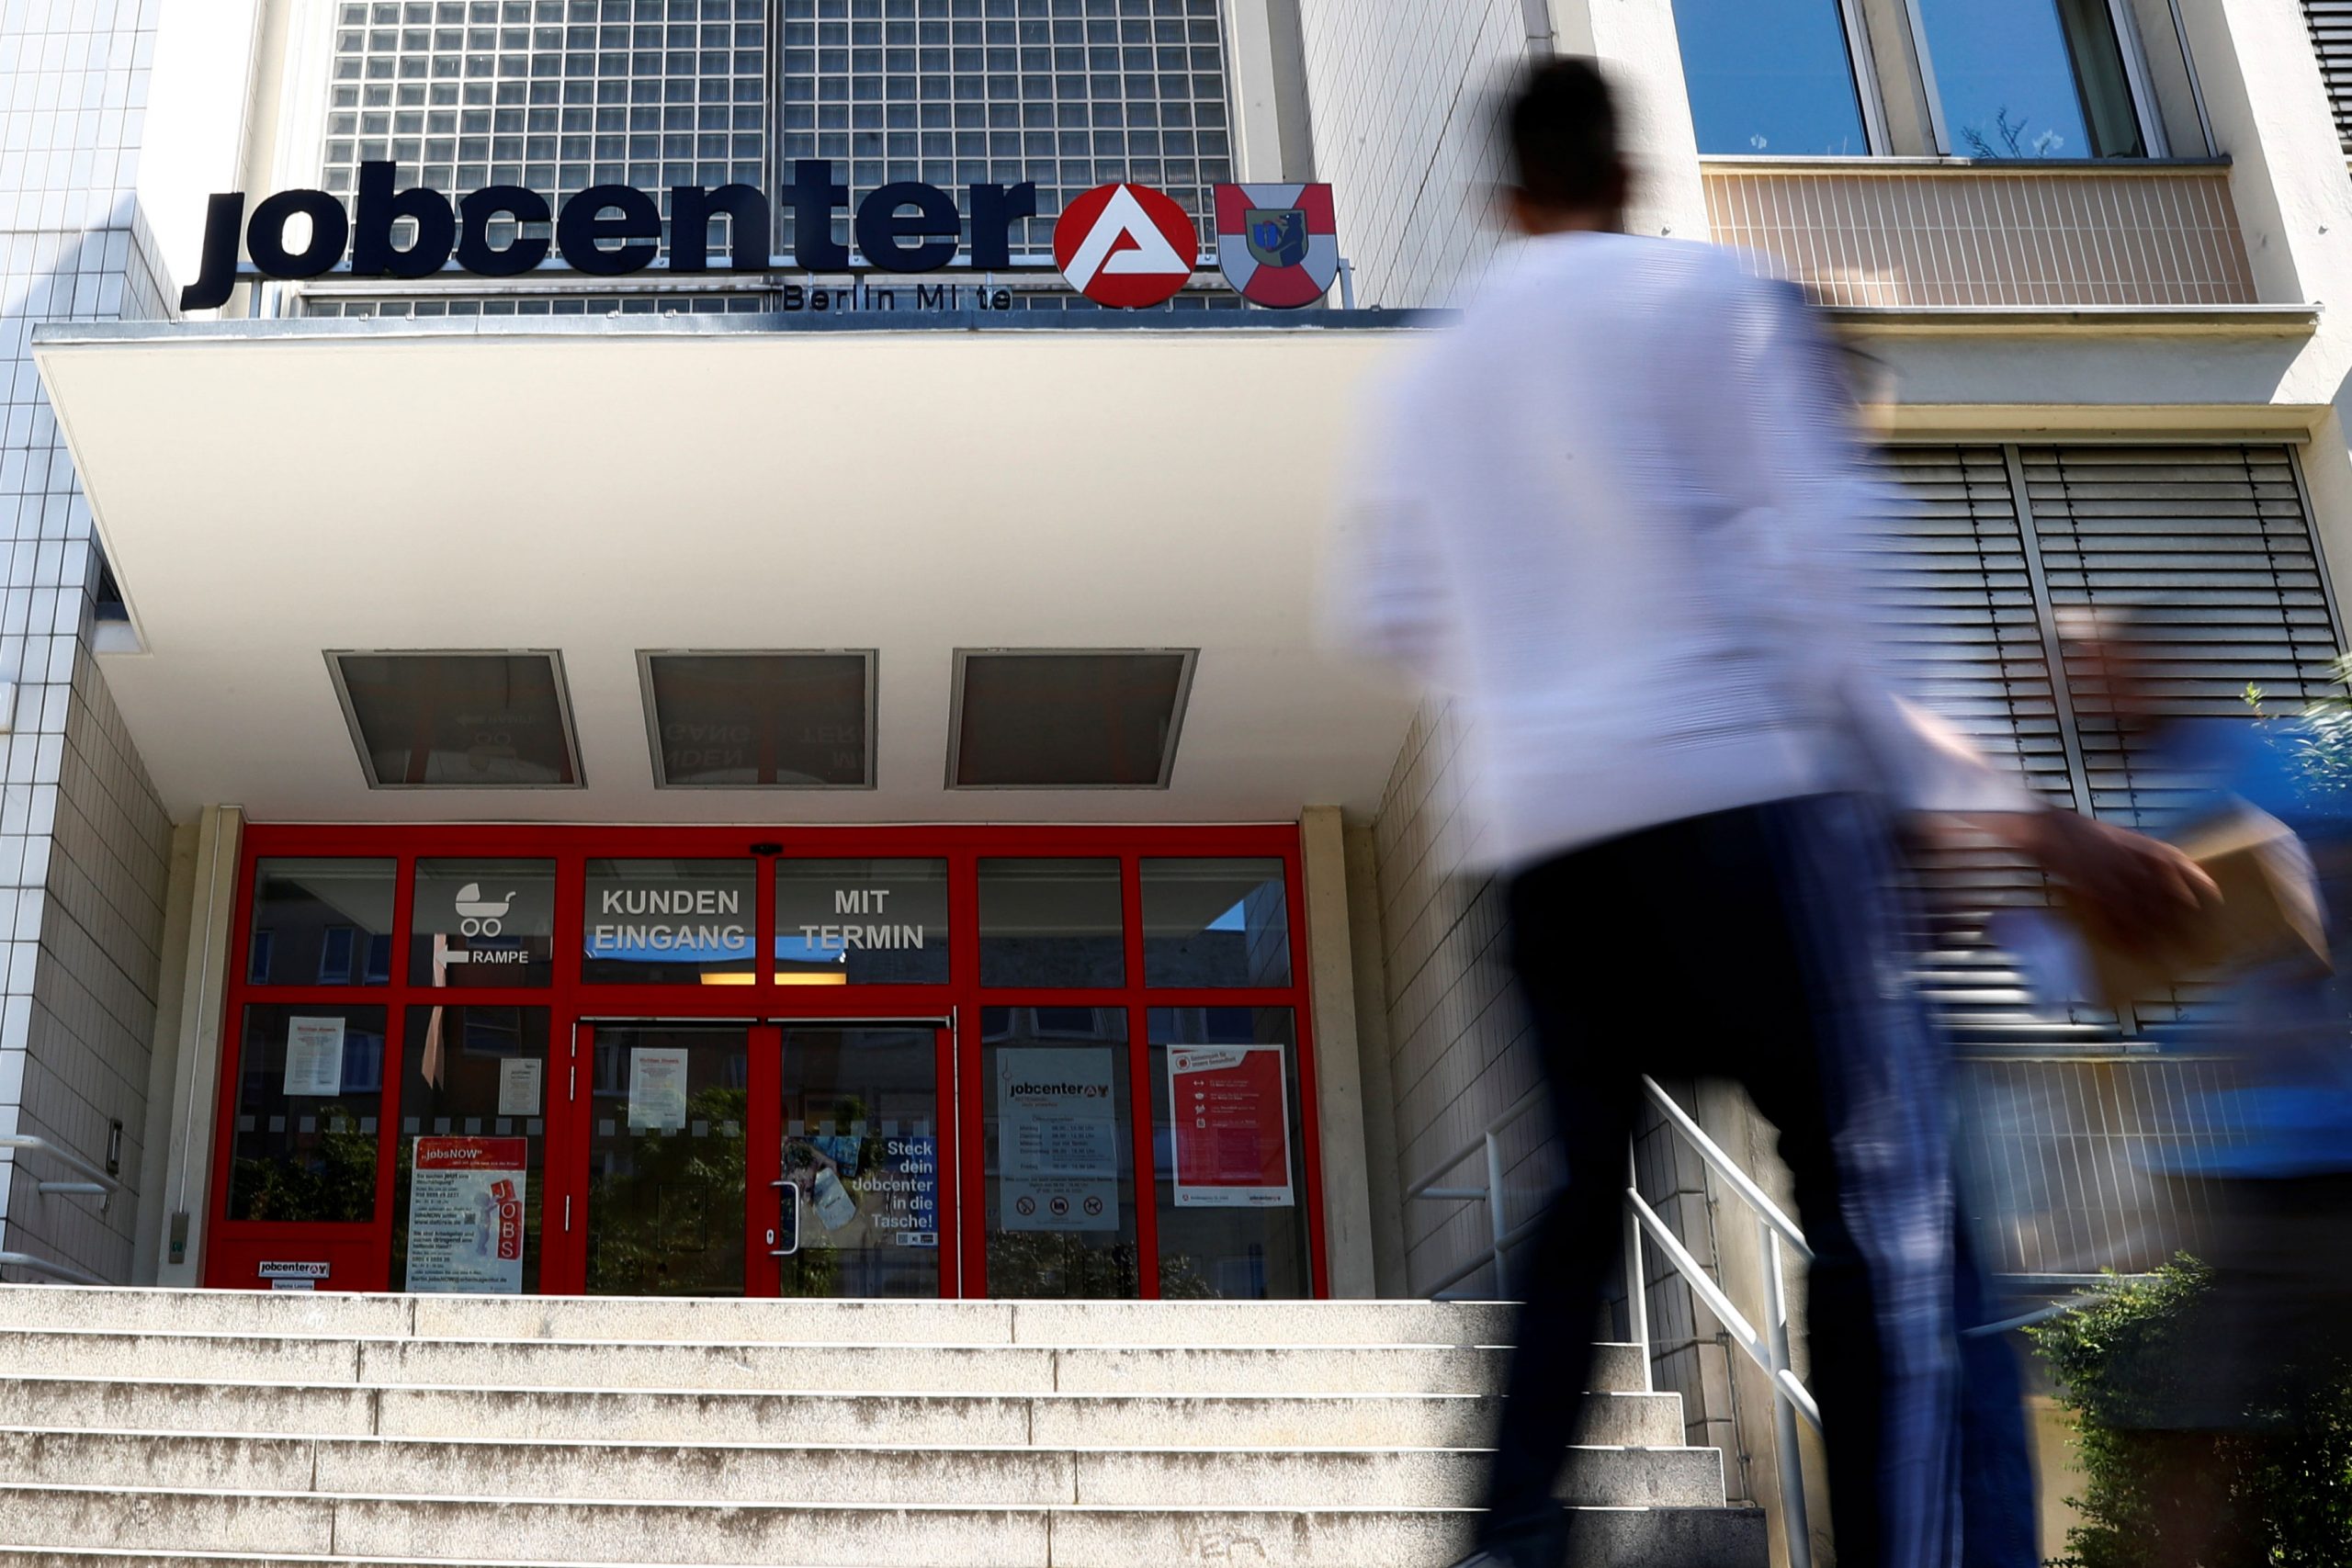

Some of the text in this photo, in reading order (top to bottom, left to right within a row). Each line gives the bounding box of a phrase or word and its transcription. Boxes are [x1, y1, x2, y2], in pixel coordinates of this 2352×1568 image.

[180, 160, 1035, 311] jobcenter
[783, 284, 1011, 310] Berlin Mite
[602, 889, 739, 914] KUNDEN
[834, 889, 889, 914] MIT
[594, 924, 746, 951] EINGANG
[799, 924, 924, 950] TERMIN
[472, 950, 529, 964] RAMPE
[1011, 1082, 1083, 1098] jobcenter
[888, 1141, 933, 1156] Steck
[899, 1159, 933, 1173] dein
[853, 1177, 933, 1191] Jobcenter
[892, 1196, 933, 1210] in die
[872, 1213, 933, 1228] Tasche!
[261, 1262, 310, 1272] jobcenter
